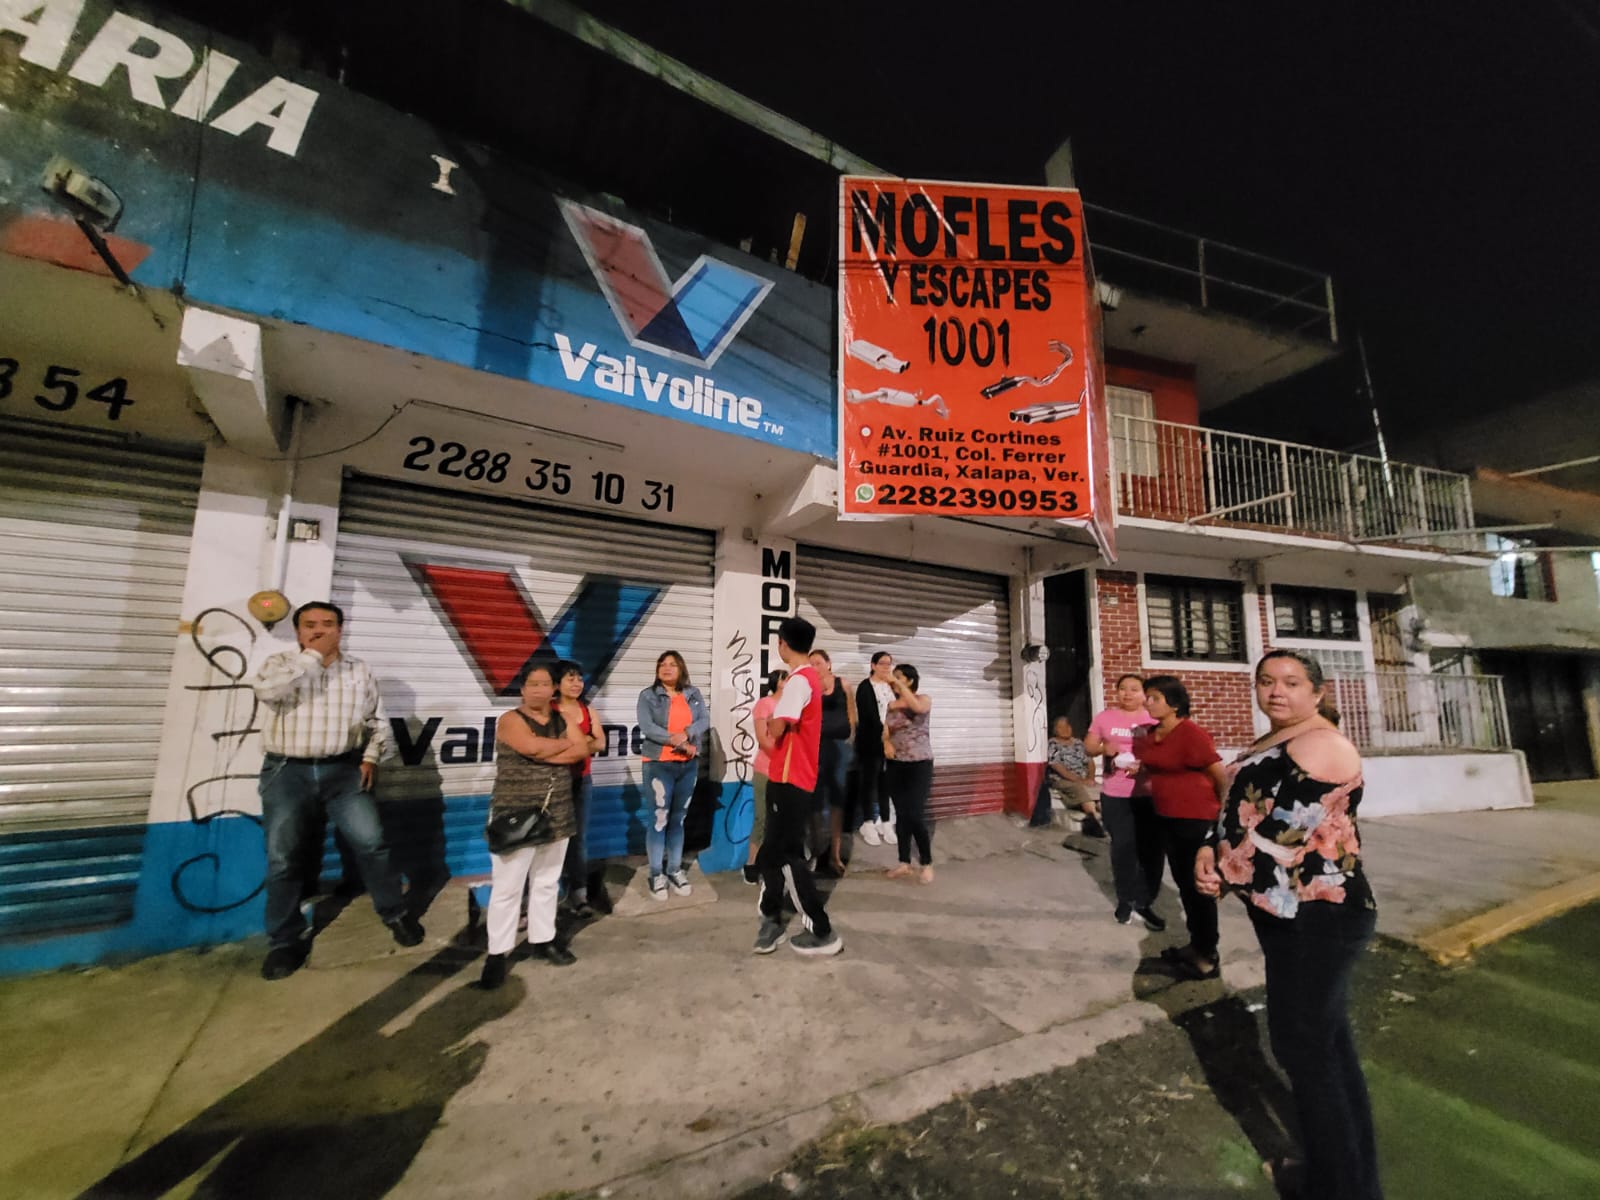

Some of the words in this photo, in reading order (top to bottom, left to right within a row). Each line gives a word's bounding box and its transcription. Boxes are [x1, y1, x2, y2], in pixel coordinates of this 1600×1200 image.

[851, 190, 1076, 265] MOFLES
[881, 259, 900, 304] Y
[909, 263, 1051, 312] ESCAPES
[922, 316, 1010, 369] 1001
[553, 332, 763, 430] Valvoline
[878, 443, 950, 463] #1001,
[955, 446, 996, 463] Col.
[1002, 448, 1067, 464] Ferrer
[881, 425, 913, 441] Av.
[919, 427, 965, 443] Ruiz
[971, 429, 1062, 446] Cortines
[403, 435, 512, 484] 2288
[525, 458, 572, 495] 35
[592, 471, 626, 505] 10
[641, 480, 675, 512] 31
[859, 460, 951, 481] Guardia,
[956, 464, 1037, 483] Xalapa,
[1043, 467, 1085, 483] Ver.
[877, 484, 1079, 512] 2282390953
